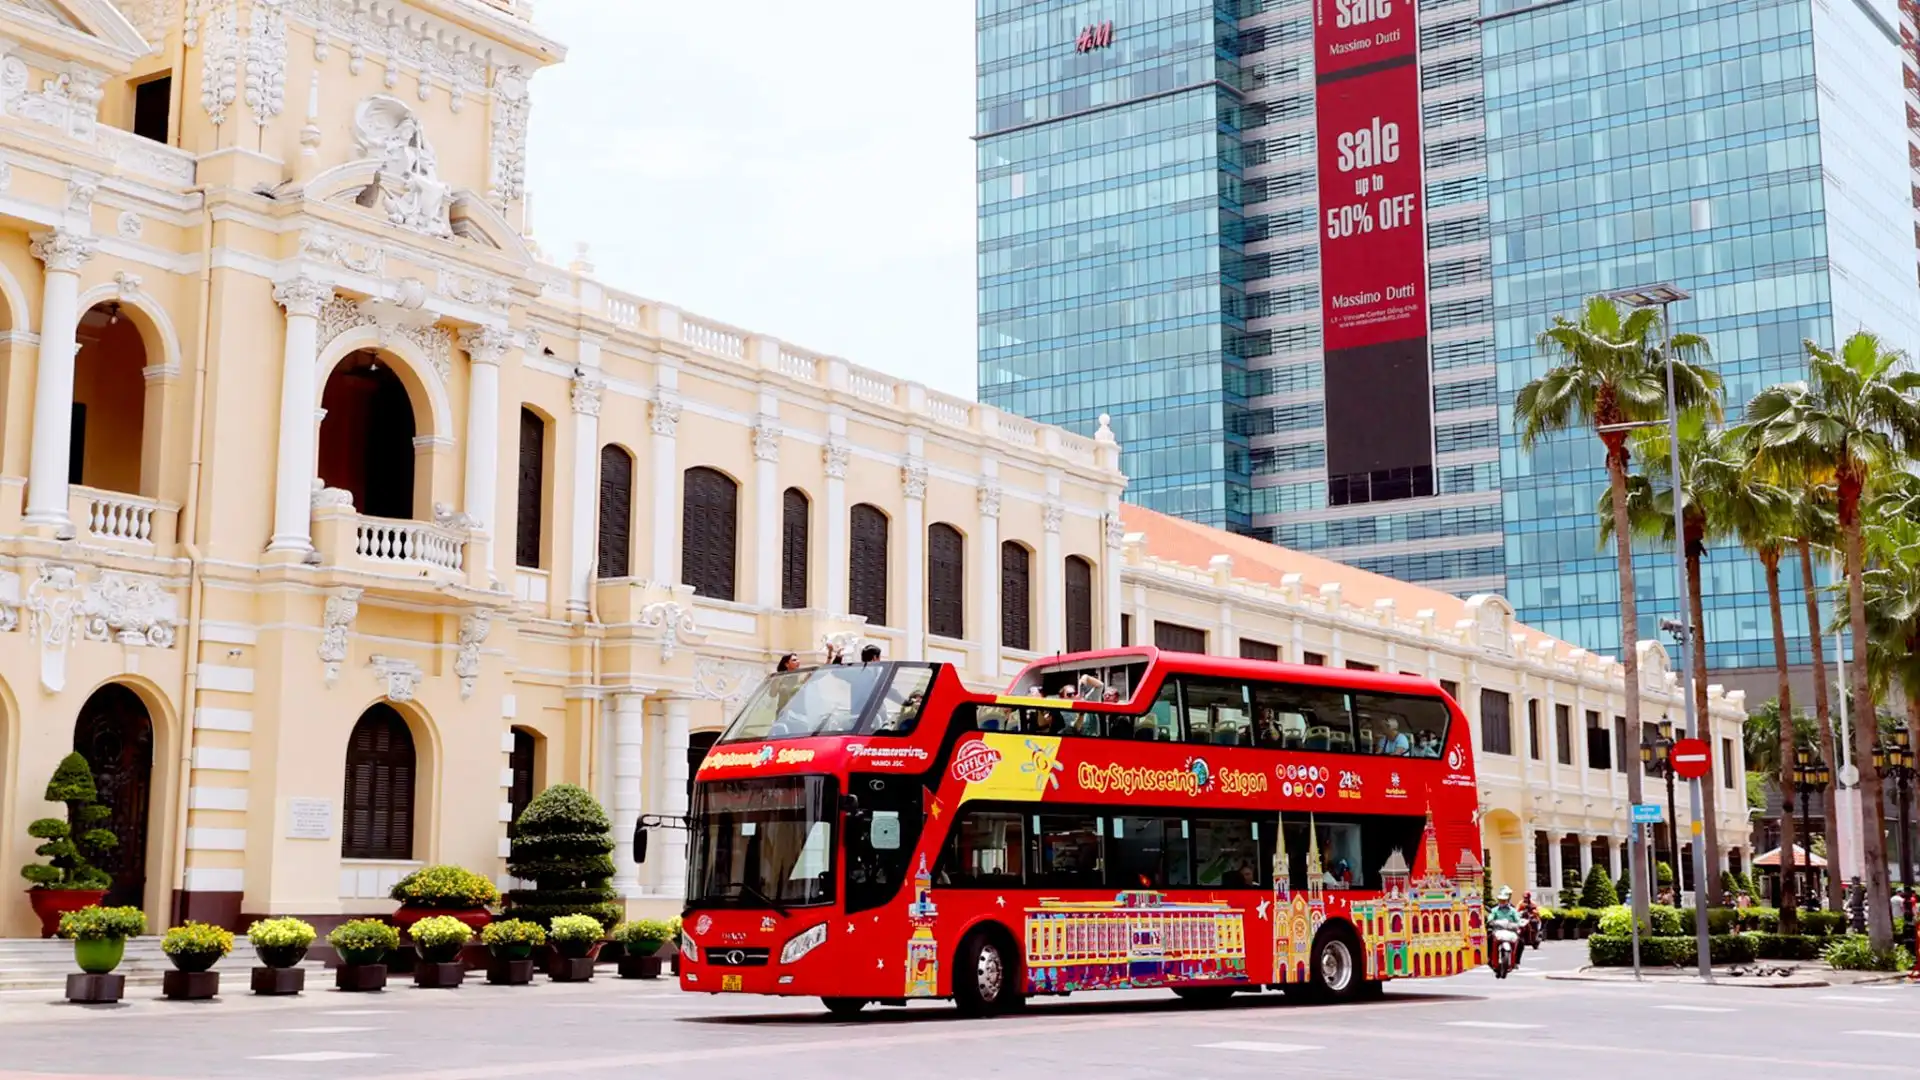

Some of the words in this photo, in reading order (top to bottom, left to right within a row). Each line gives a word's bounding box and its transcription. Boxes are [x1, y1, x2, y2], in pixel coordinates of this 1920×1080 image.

[1329, 38, 1371, 56] Massimo
[1376, 28, 1401, 46] Dutti
[1337, 116, 1400, 172] sale
[1355, 177, 1369, 197] up
[1372, 174, 1384, 192] to
[1327, 202, 1373, 239] 50%
[1379, 193, 1415, 230] OFF
[1331, 291, 1381, 309] Massimo
[1386, 283, 1415, 301] Dutti
[957, 750, 998, 776] OFFICIAL
[1219, 767, 1267, 796] Saigon
